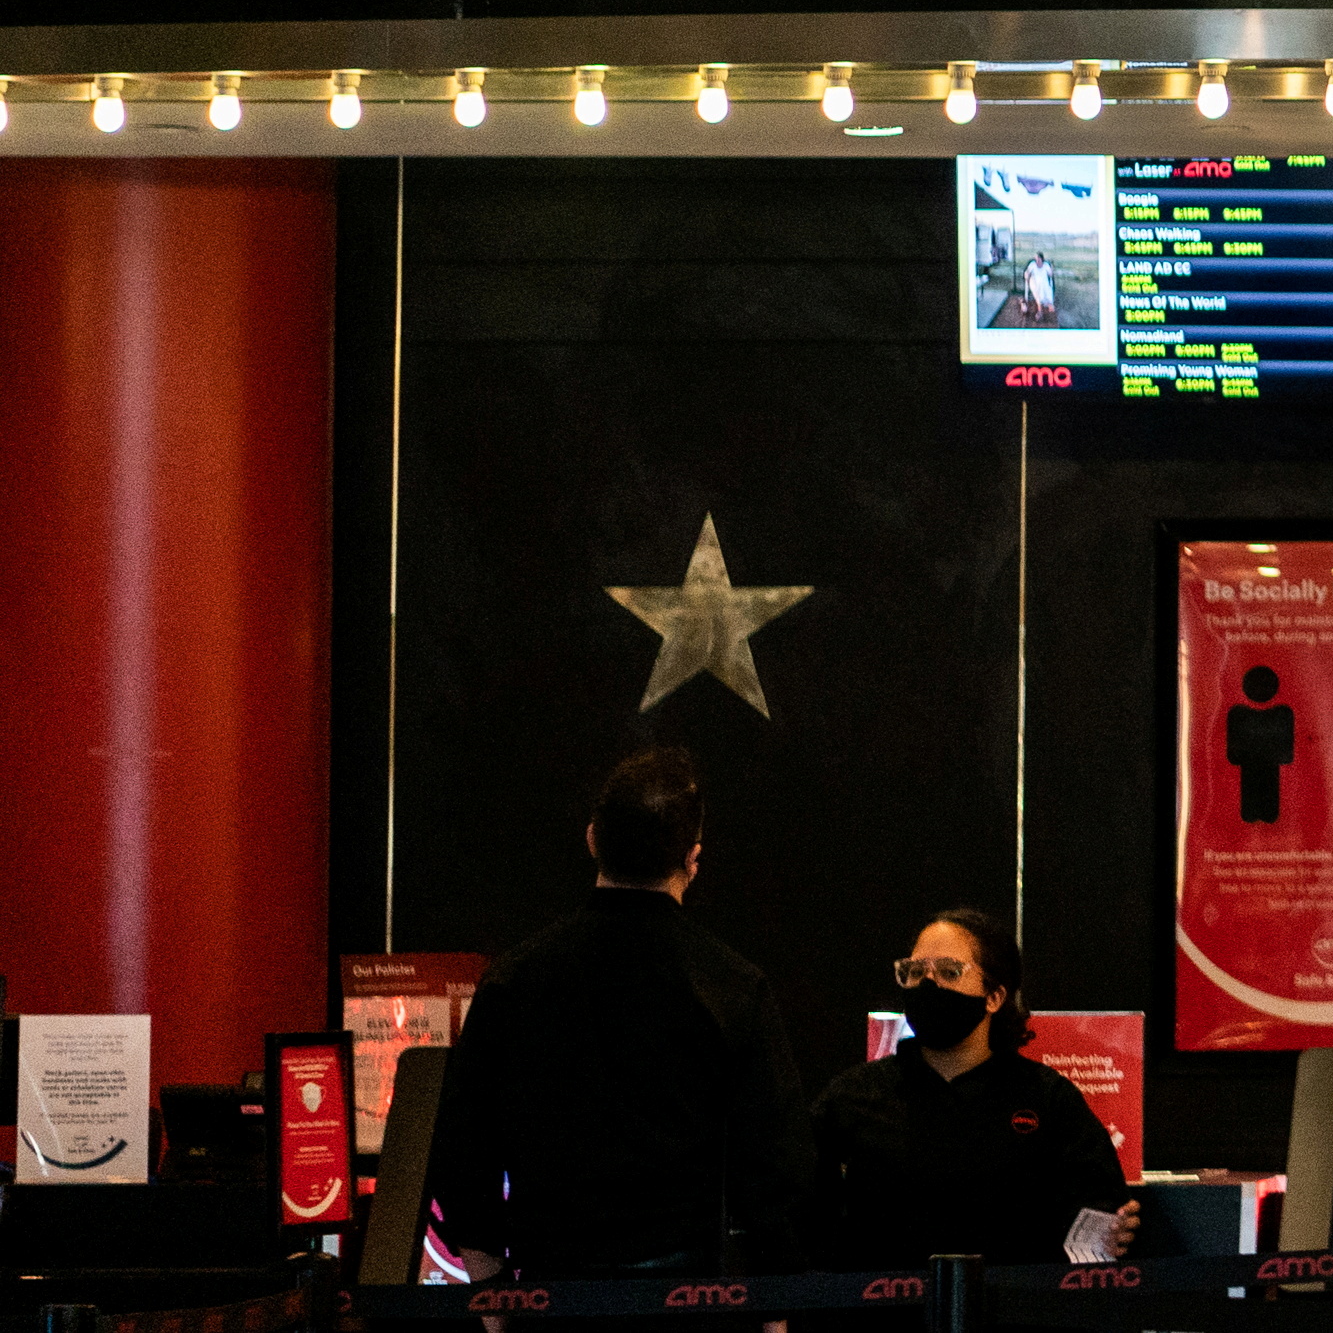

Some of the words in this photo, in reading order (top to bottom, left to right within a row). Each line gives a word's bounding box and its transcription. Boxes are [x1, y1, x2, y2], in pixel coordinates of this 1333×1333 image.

[1135, 162, 1172, 178] Laser
[1118, 192, 1158, 207] Boogie
[1119, 227, 1154, 241] Chaos
[1155, 227, 1201, 242] Walking
[1119, 262, 1152, 275] LAND
[1154, 262, 1172, 275] AD
[1174, 262, 1191, 275] CC
[1120, 295, 1150, 309] News
[1152, 295, 1167, 309] Of
[1168, 296, 1190, 310] The
[1191, 296, 1226, 310] World
[1120, 329, 1184, 343] Nomadland
[1121, 364, 1176, 379] Promising
[1178, 364, 1213, 378] Young
[1215, 365, 1258, 378] Woman
[1204, 579, 1236, 602] Be
[1239, 579, 1327, 606] Socially
[1273, 630, 1317, 646] during
[352, 964, 373, 978] Our
[375, 963, 416, 977] Policies
[1293, 973, 1323, 987] Safe
[1042, 1054, 1113, 1067] Disinfecting
[1070, 1067, 1124, 1079] Available
[861, 1276, 925, 1300] am
